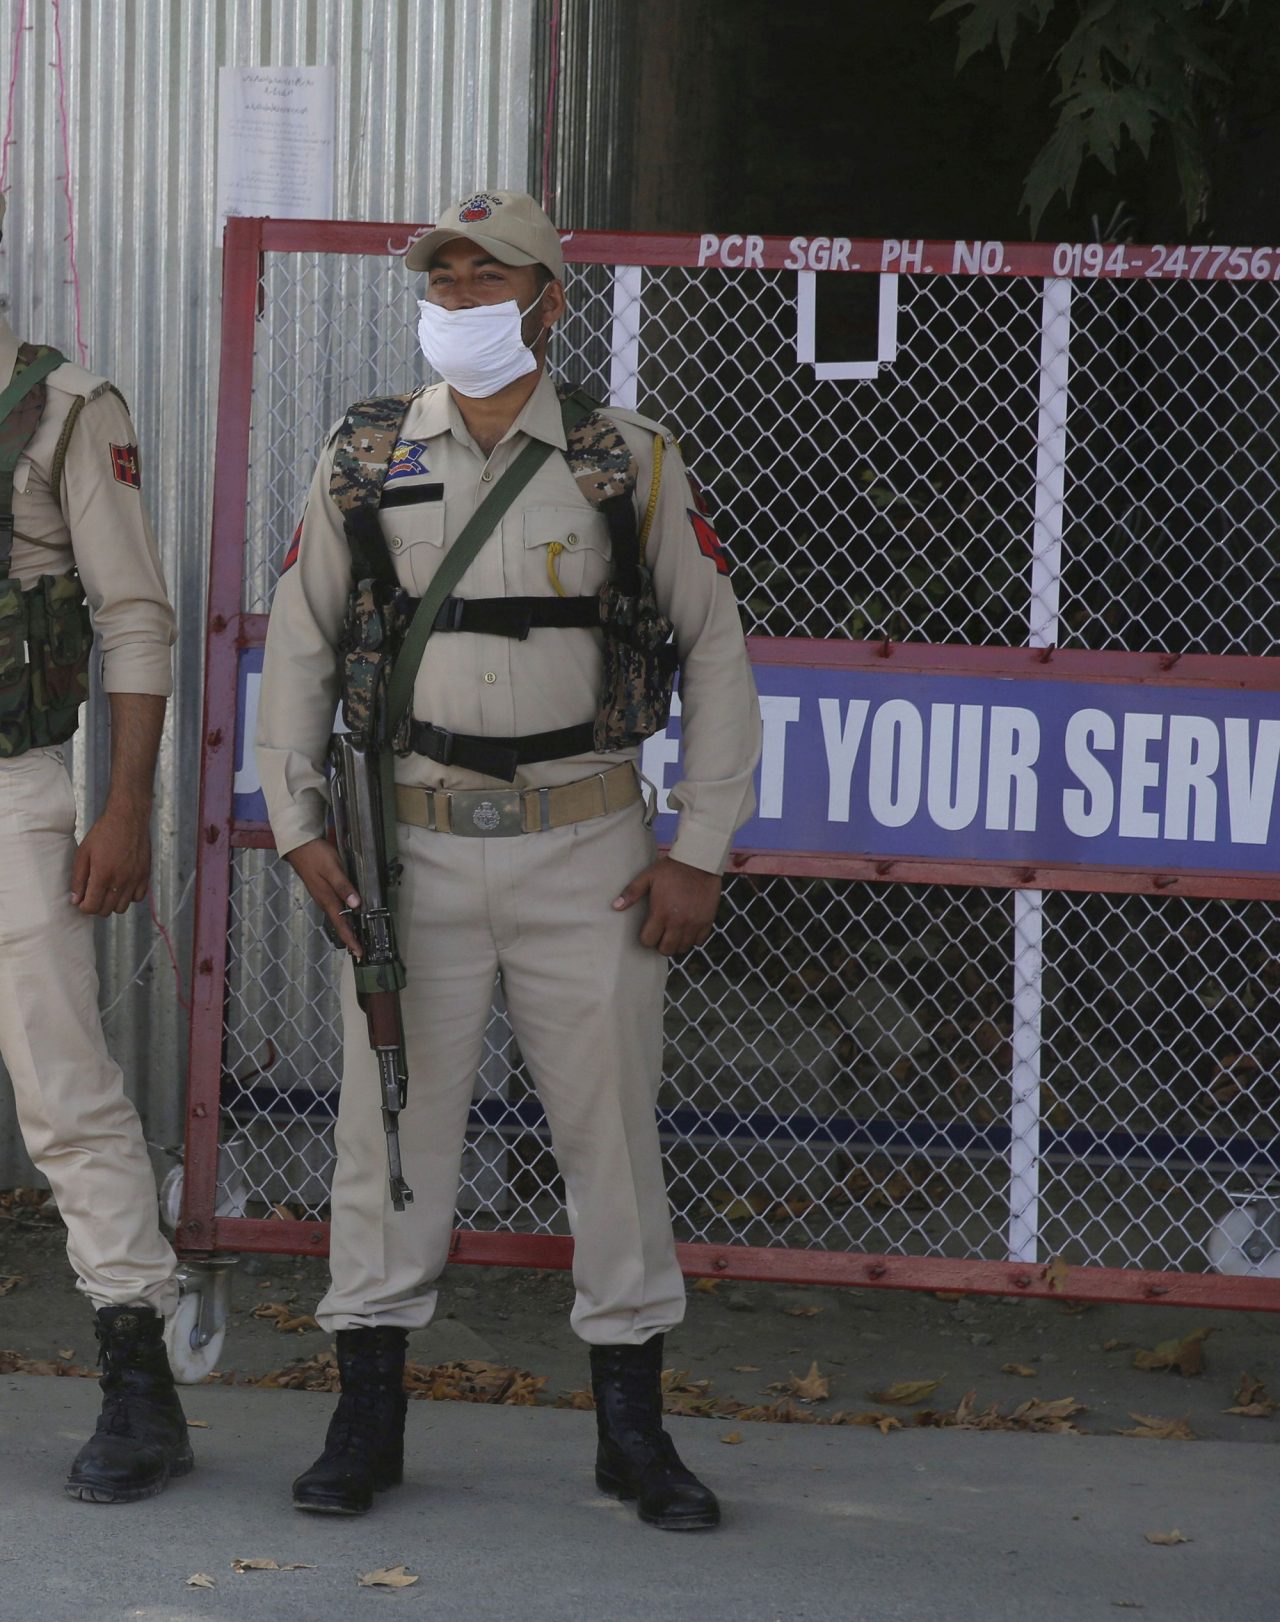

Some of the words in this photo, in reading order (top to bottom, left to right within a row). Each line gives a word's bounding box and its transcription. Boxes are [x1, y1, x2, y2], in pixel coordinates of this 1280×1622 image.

[697, 233, 765, 269] PCR
[783, 236, 861, 271] SGR.
[880, 238, 934, 273] PH.
[951, 240, 1013, 275] NO.
[818, 697, 1042, 832] YOUR
